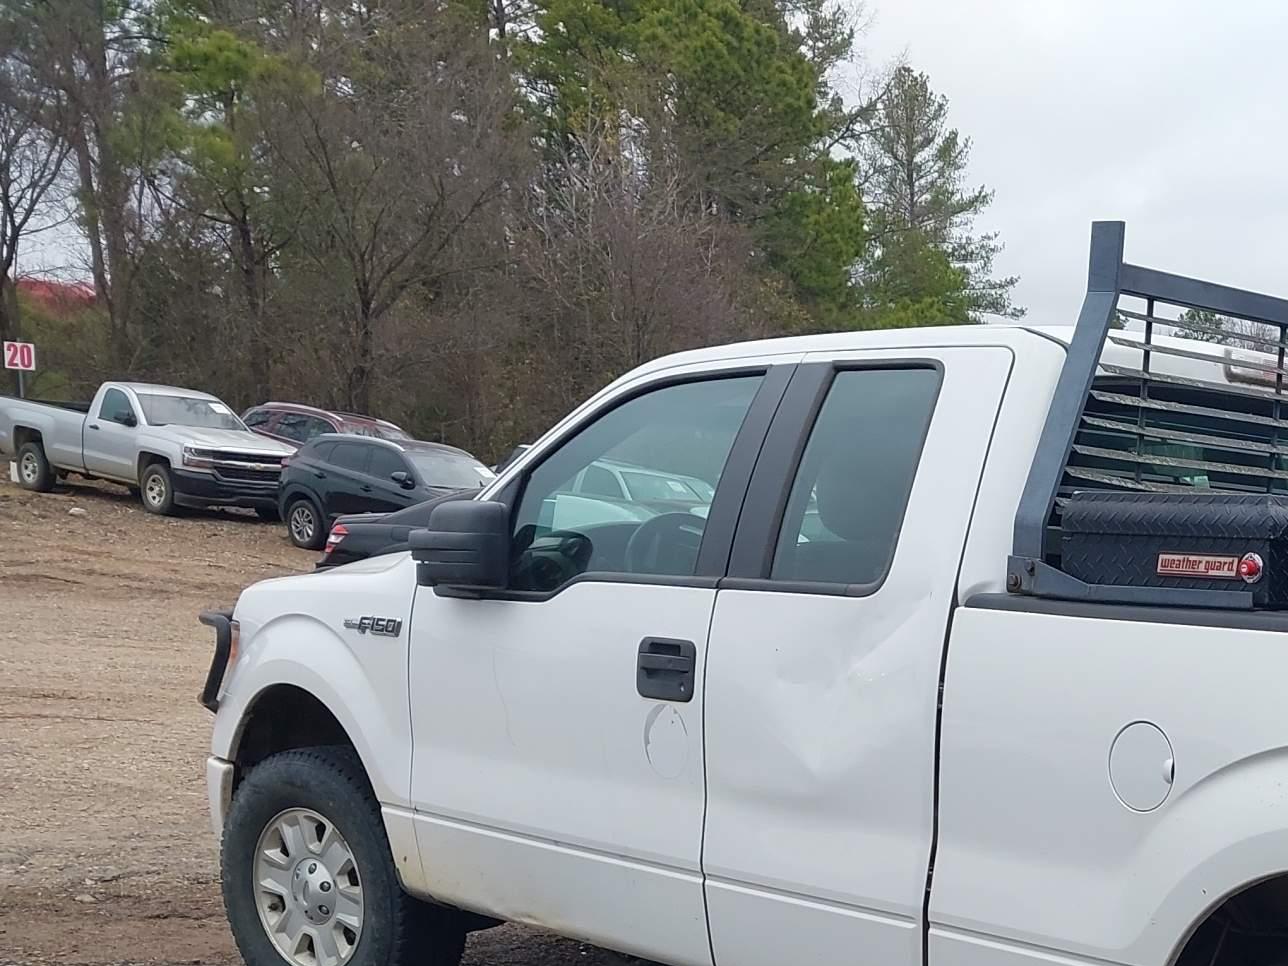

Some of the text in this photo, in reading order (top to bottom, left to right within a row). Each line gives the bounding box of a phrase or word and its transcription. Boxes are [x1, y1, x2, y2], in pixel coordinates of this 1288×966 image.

[7, 343, 32, 368] 20
[1160, 557, 1235, 572] weather guard
